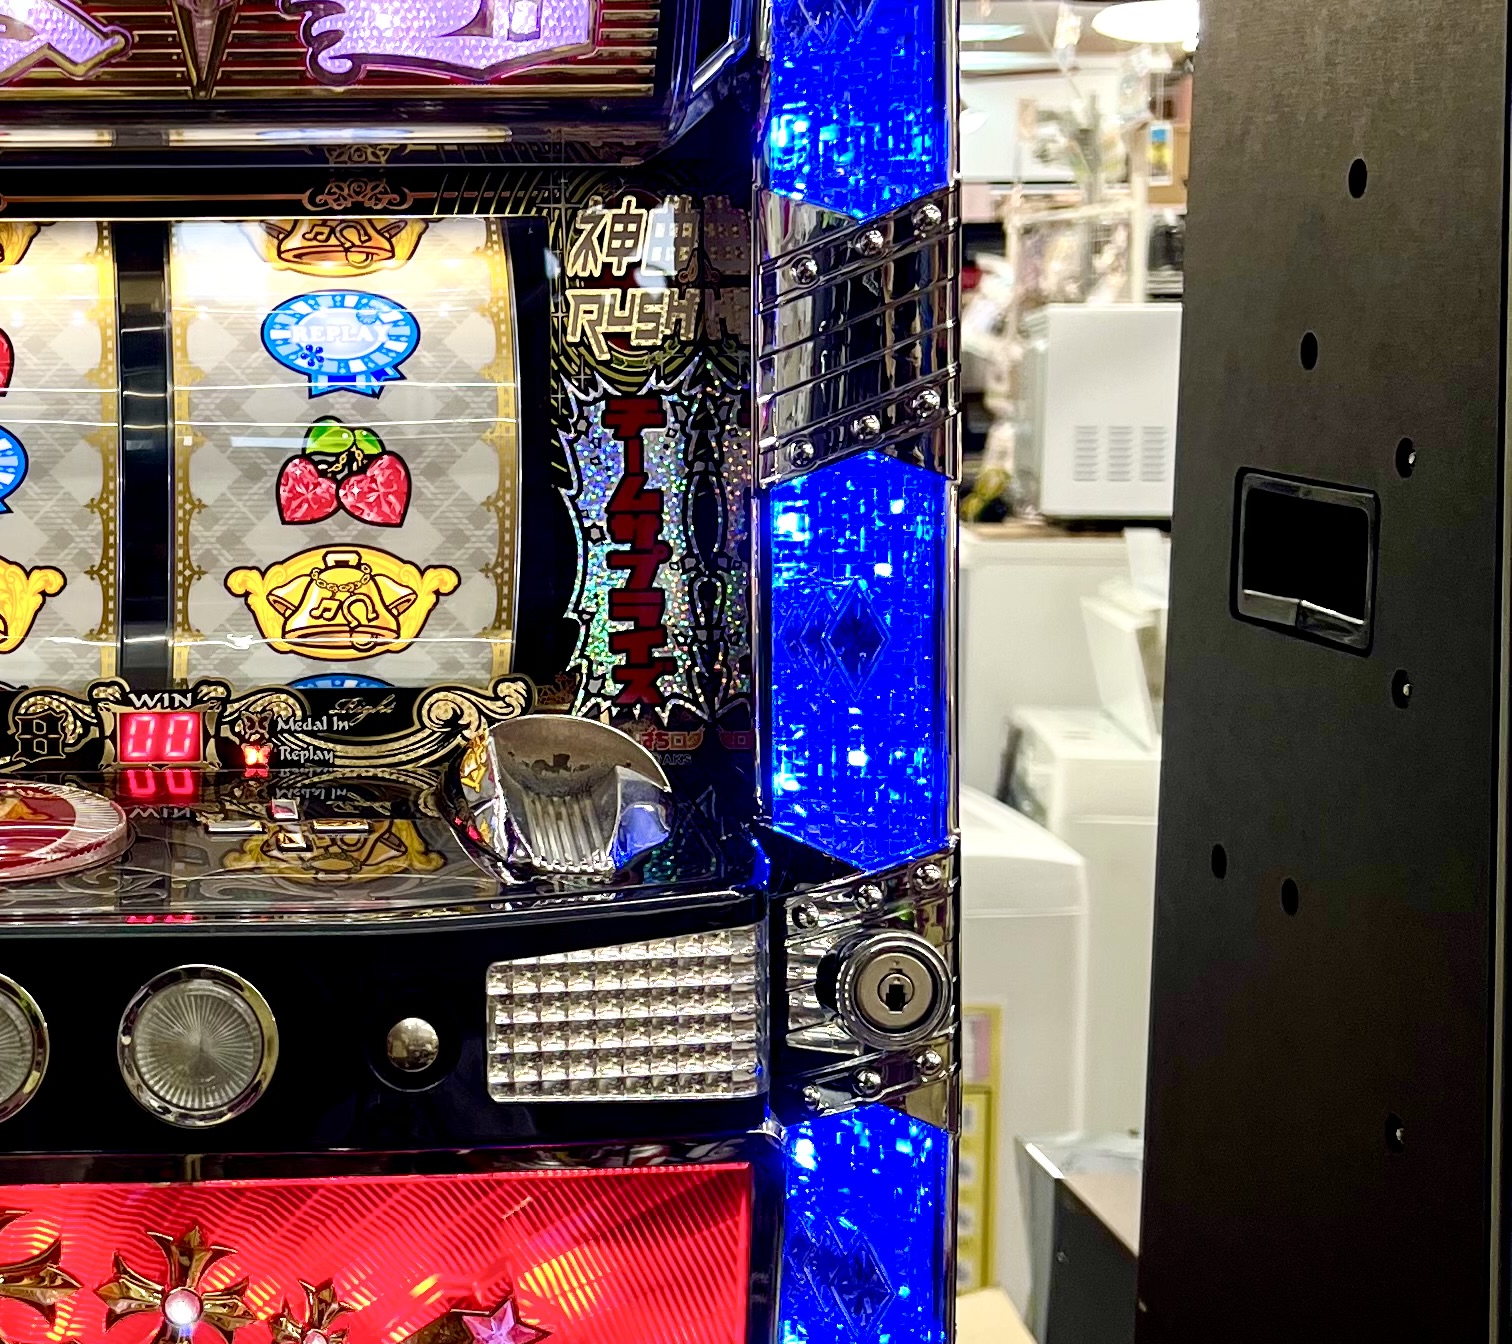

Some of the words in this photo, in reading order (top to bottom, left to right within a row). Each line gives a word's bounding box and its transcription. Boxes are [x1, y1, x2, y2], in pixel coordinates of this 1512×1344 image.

[565, 194, 702, 277] 神曲
[290, 324, 393, 344] REPLAY
[565, 287, 703, 361] RUSH
[604, 395, 669, 705] チームサプライズ
[129, 693, 193, 708] WIN
[127, 714, 193, 758] 00
[277, 716, 323, 732] Medal
[326, 716, 350, 732] In
[278, 744, 335, 764] Replay
